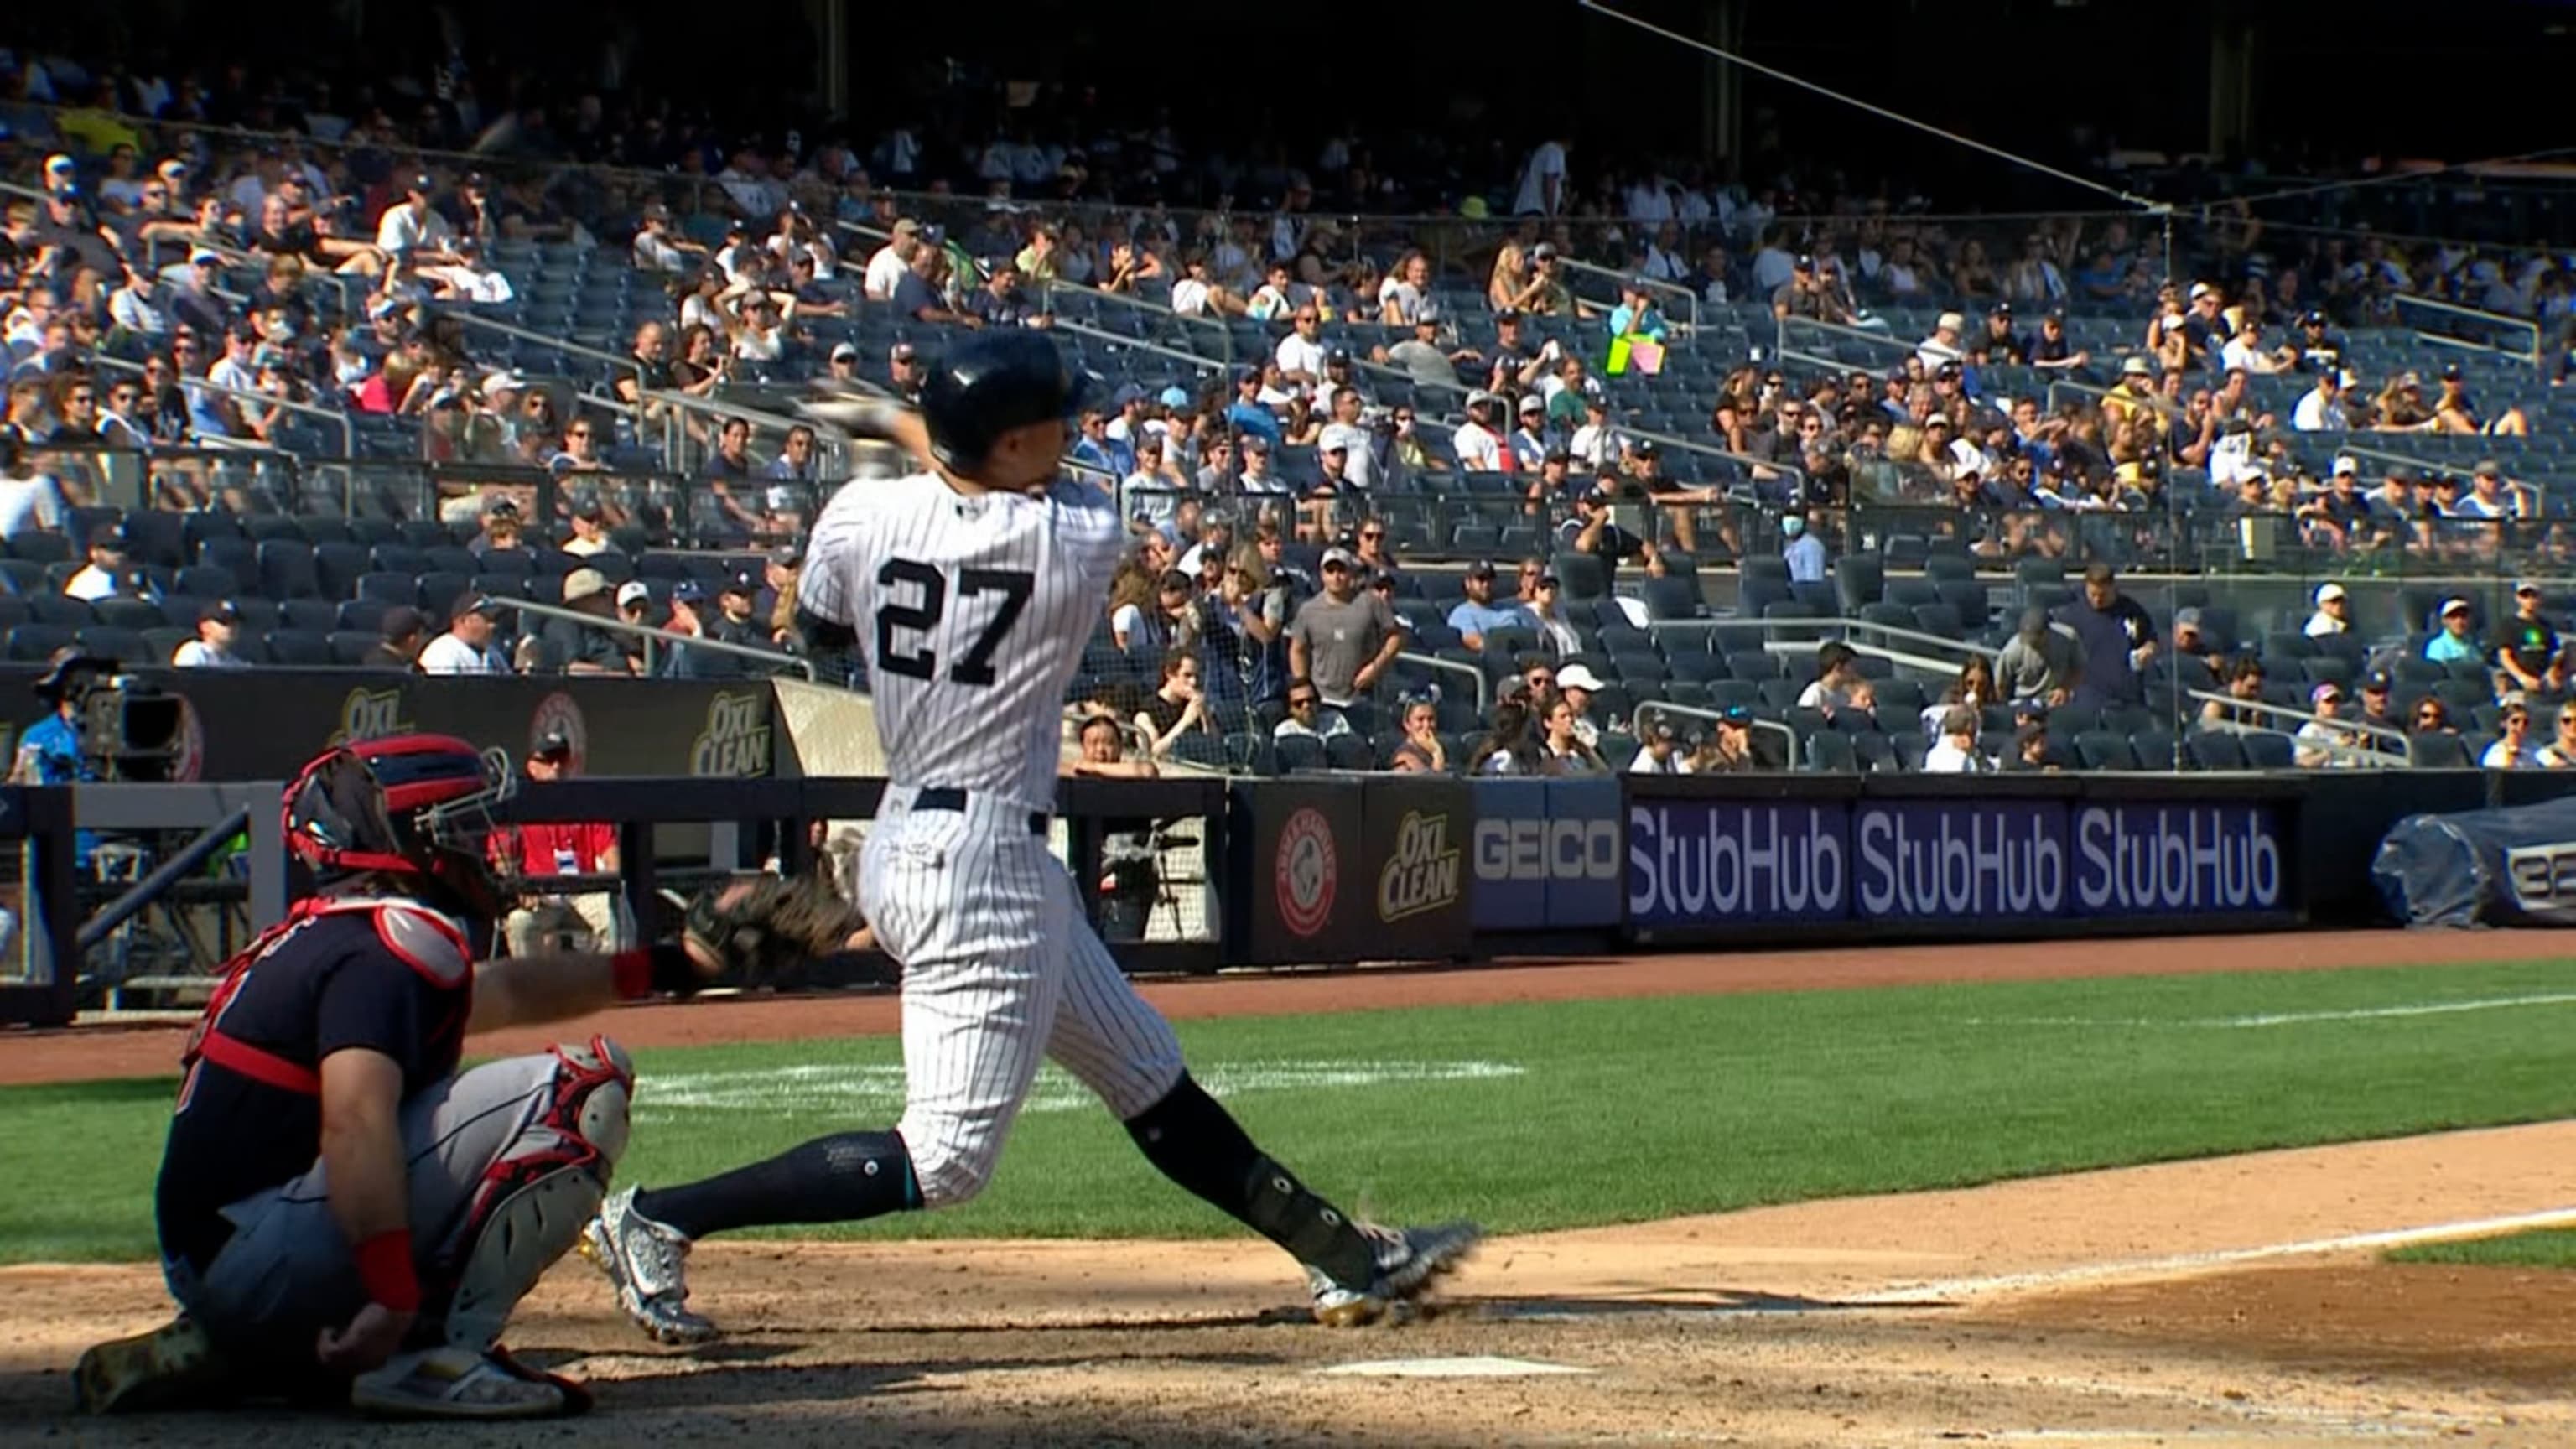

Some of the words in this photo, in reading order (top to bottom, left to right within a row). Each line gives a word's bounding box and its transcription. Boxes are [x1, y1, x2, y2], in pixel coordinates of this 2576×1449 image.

[876, 556, 1036, 686] 27
[346, 692, 399, 737] OXI
[711, 698, 755, 743] OXI
[696, 731, 768, 777] CLEAN
[1398, 816, 1443, 869] OXI
[1473, 818, 1621, 880] GEICO
[1630, 806, 1841, 914] StubHub
[1859, 811, 2062, 914] StubHub
[2079, 808, 2280, 907] StubHub
[1382, 855, 1460, 916] CLEAN
